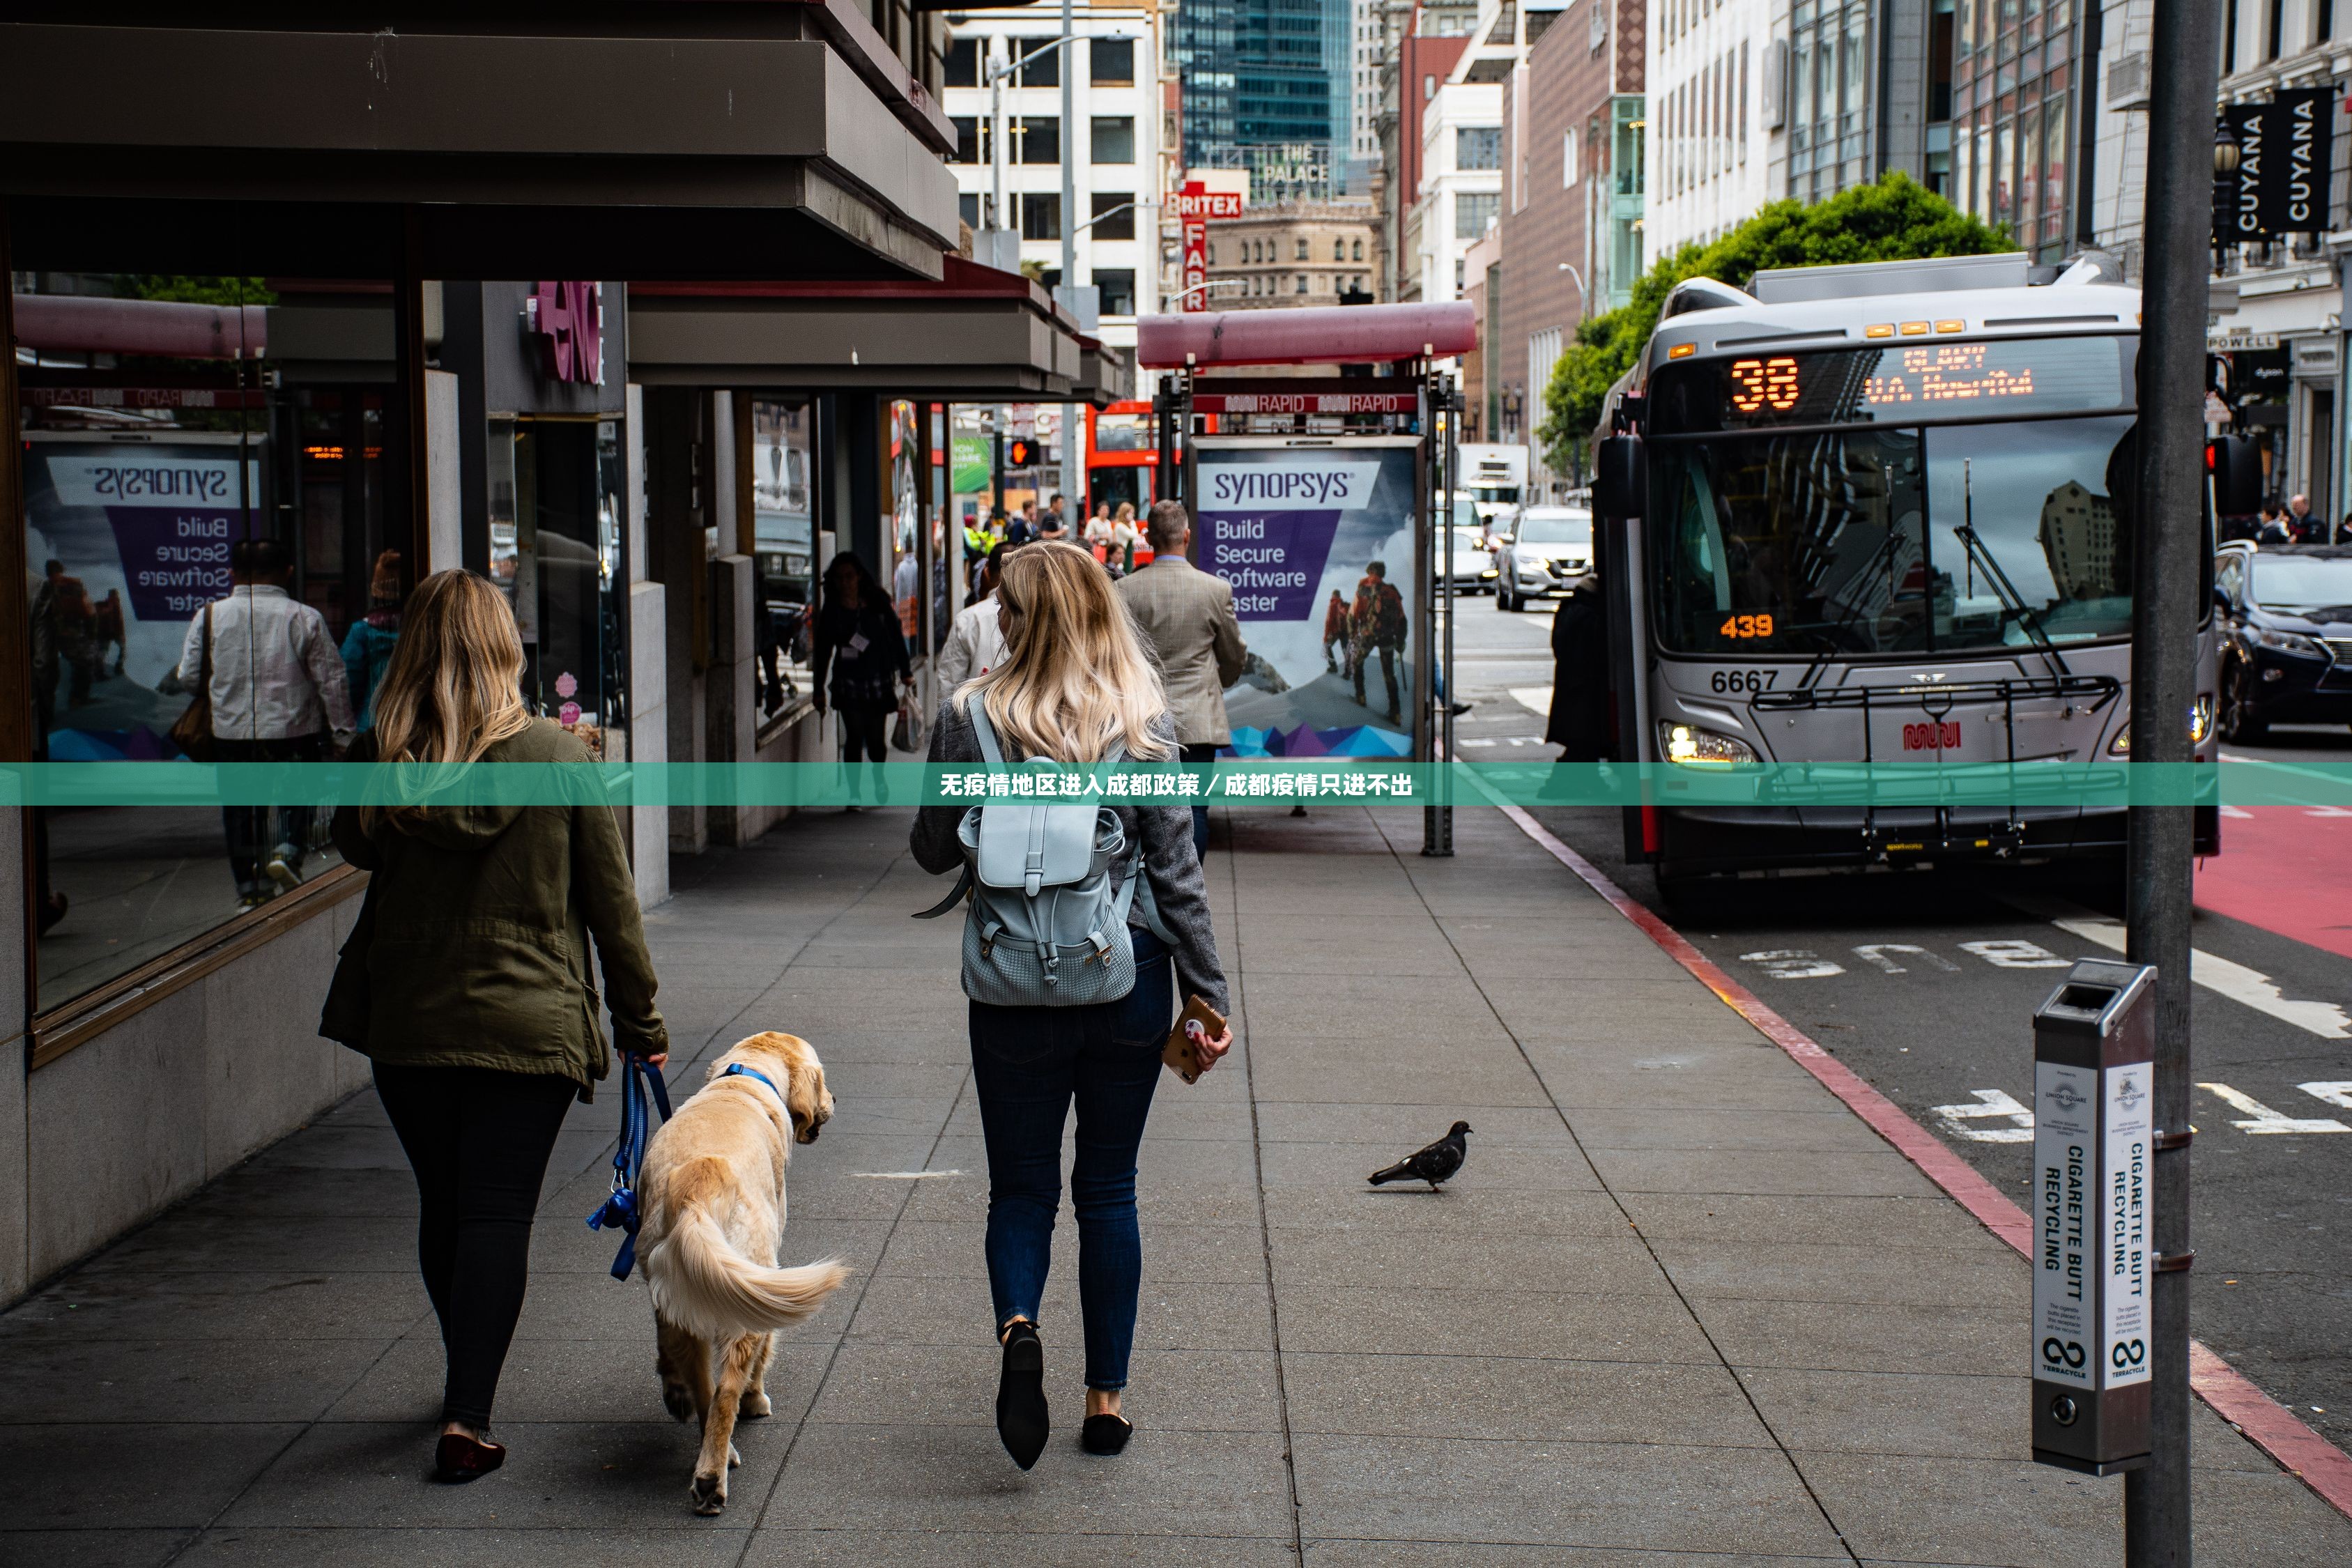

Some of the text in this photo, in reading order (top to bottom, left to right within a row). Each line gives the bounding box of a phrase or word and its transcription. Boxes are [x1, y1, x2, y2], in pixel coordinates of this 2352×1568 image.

[1282, 143, 1313, 162] THE
[2289, 99, 2314, 222] CUYANA
[1263, 164, 1328, 183] PALACE
[2238, 115, 2263, 231] CUYANA
[1167, 193, 1240, 217] BRITEX
[2207, 336, 2275, 348] POWELL
[1732, 358, 1799, 412] 38
[1259, 395, 1305, 413] RAPID
[1352, 395, 1397, 413] RAPID
[1215, 472, 1349, 505] SYNOPSYS
[1215, 518, 1265, 540] Build
[1215, 544, 1285, 564] Secure
[1231, 593, 1279, 612] aster
[1720, 613, 1774, 639] 439
[1711, 669, 1779, 693] 6667
[2045, 1091, 2087, 1104] UNION SQUARE
[2114, 1092, 2146, 1103] UNION SQUARE
[2045, 1167, 2061, 1271] RECYCLING
[2067, 1145, 2084, 1302] CIGARETTE BUTT
[2114, 1171, 2126, 1275] RECYCLING
[2130, 1142, 2143, 1297] CIGARETTE BUTT
[2047, 1309, 2060, 1318] butts
[2061, 1312, 2077, 1321] placed
[2050, 1302, 2079, 1314] The cigarette
[2125, 1304, 2140, 1313] cigarette
[2126, 1312, 2137, 1320] placed
[2058, 1319, 2081, 1328] receptacle
[2125, 1318, 2142, 1327] receptacle
[2043, 1364, 2086, 1379] TERRACYCLE
[2112, 1366, 2146, 1378] TERRACYCLE
